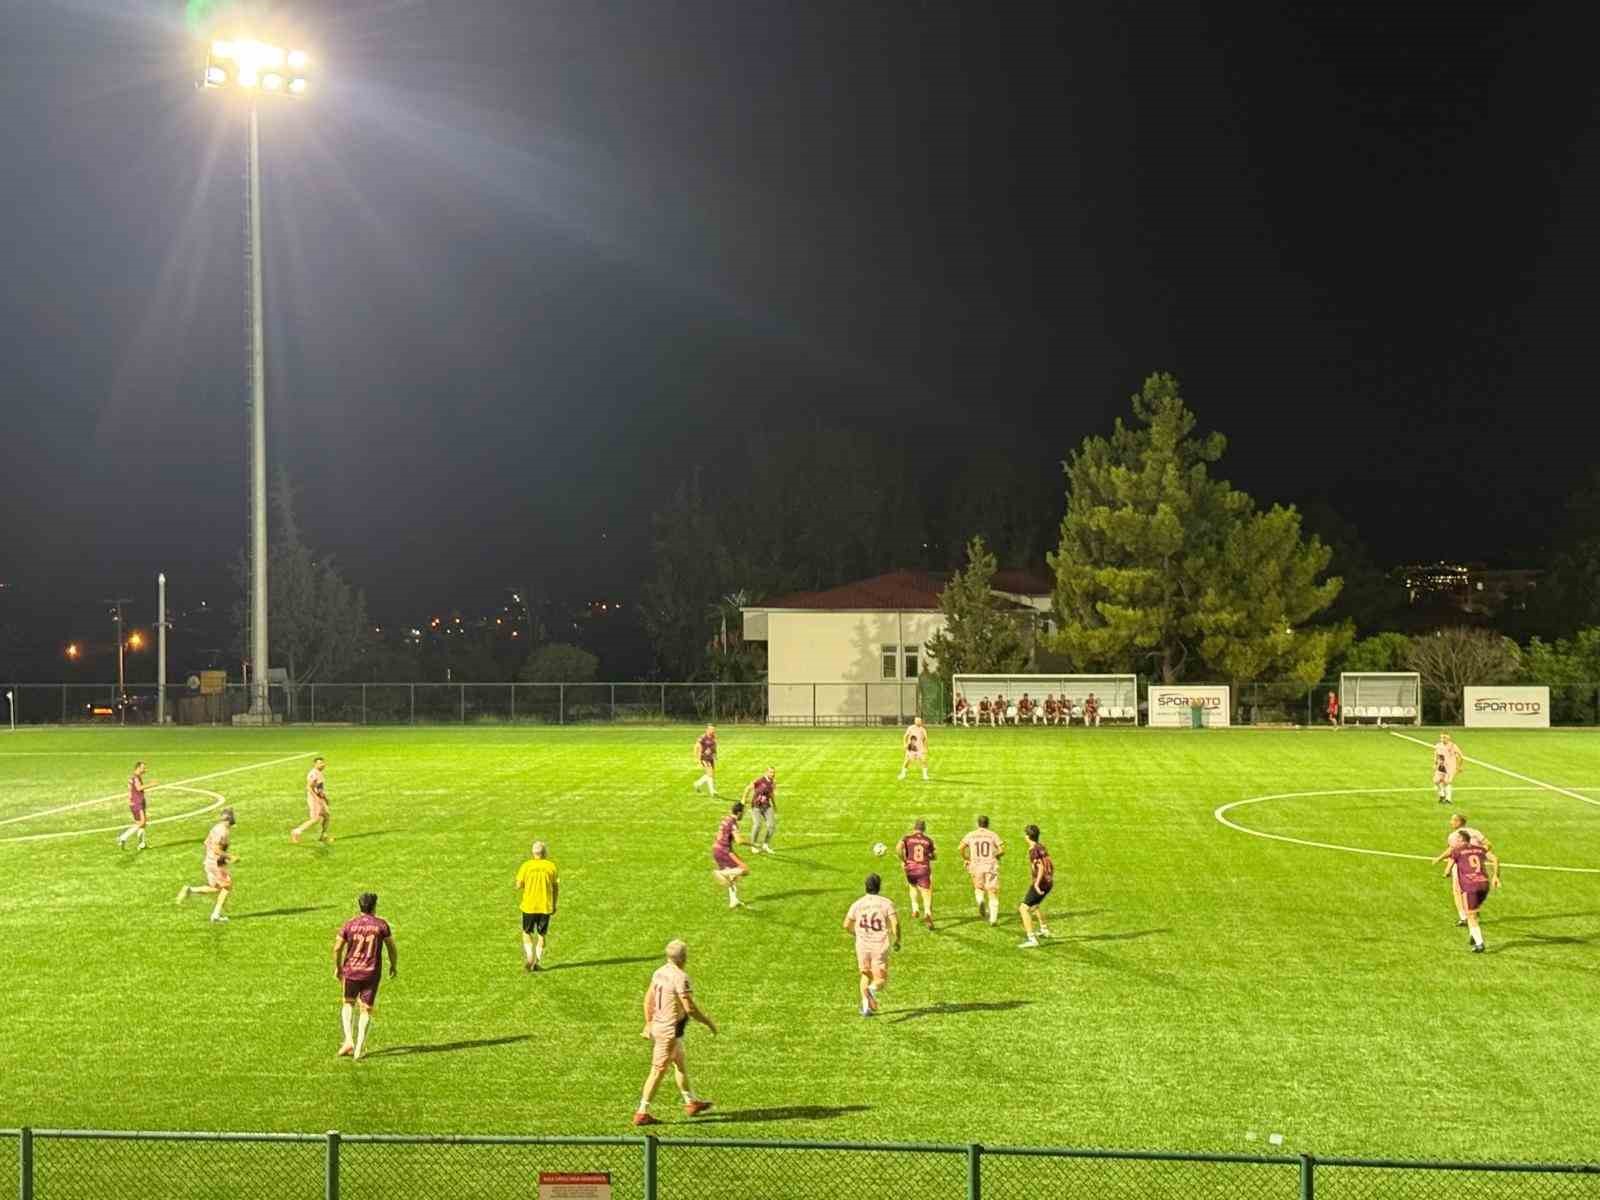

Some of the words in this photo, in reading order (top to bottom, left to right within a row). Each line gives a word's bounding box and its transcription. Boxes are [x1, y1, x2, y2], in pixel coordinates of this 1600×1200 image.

[1474, 701, 1541, 712] SPORTOTO
[974, 841, 990, 857] 10
[1468, 854, 1481, 873] 9
